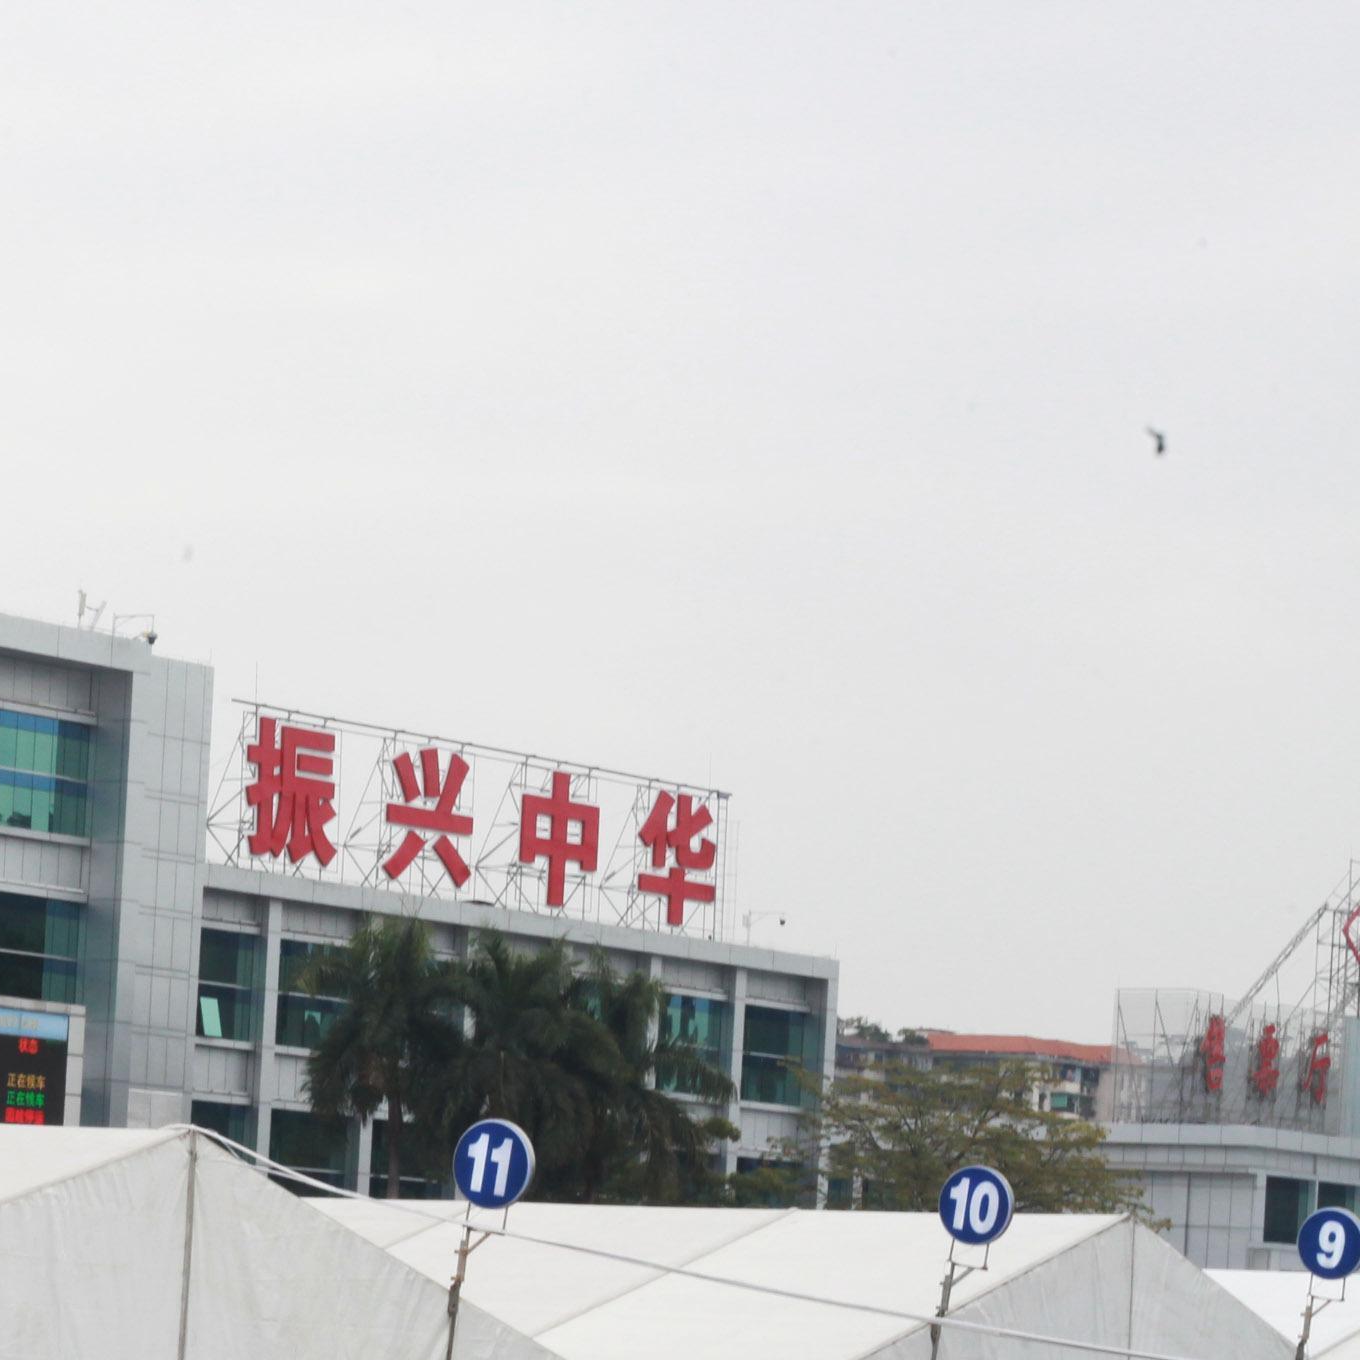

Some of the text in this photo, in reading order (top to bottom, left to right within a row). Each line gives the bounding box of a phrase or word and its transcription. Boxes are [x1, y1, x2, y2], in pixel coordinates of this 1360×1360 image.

[245, 716, 717, 926] 振兴中华
[6, 1072, 46, 1090] 正在候车
[6, 1091, 46, 1108] 正在候车
[467, 1133, 513, 1197] 11
[950, 1177, 999, 1234] 10
[1317, 1221, 1346, 1269] 9
